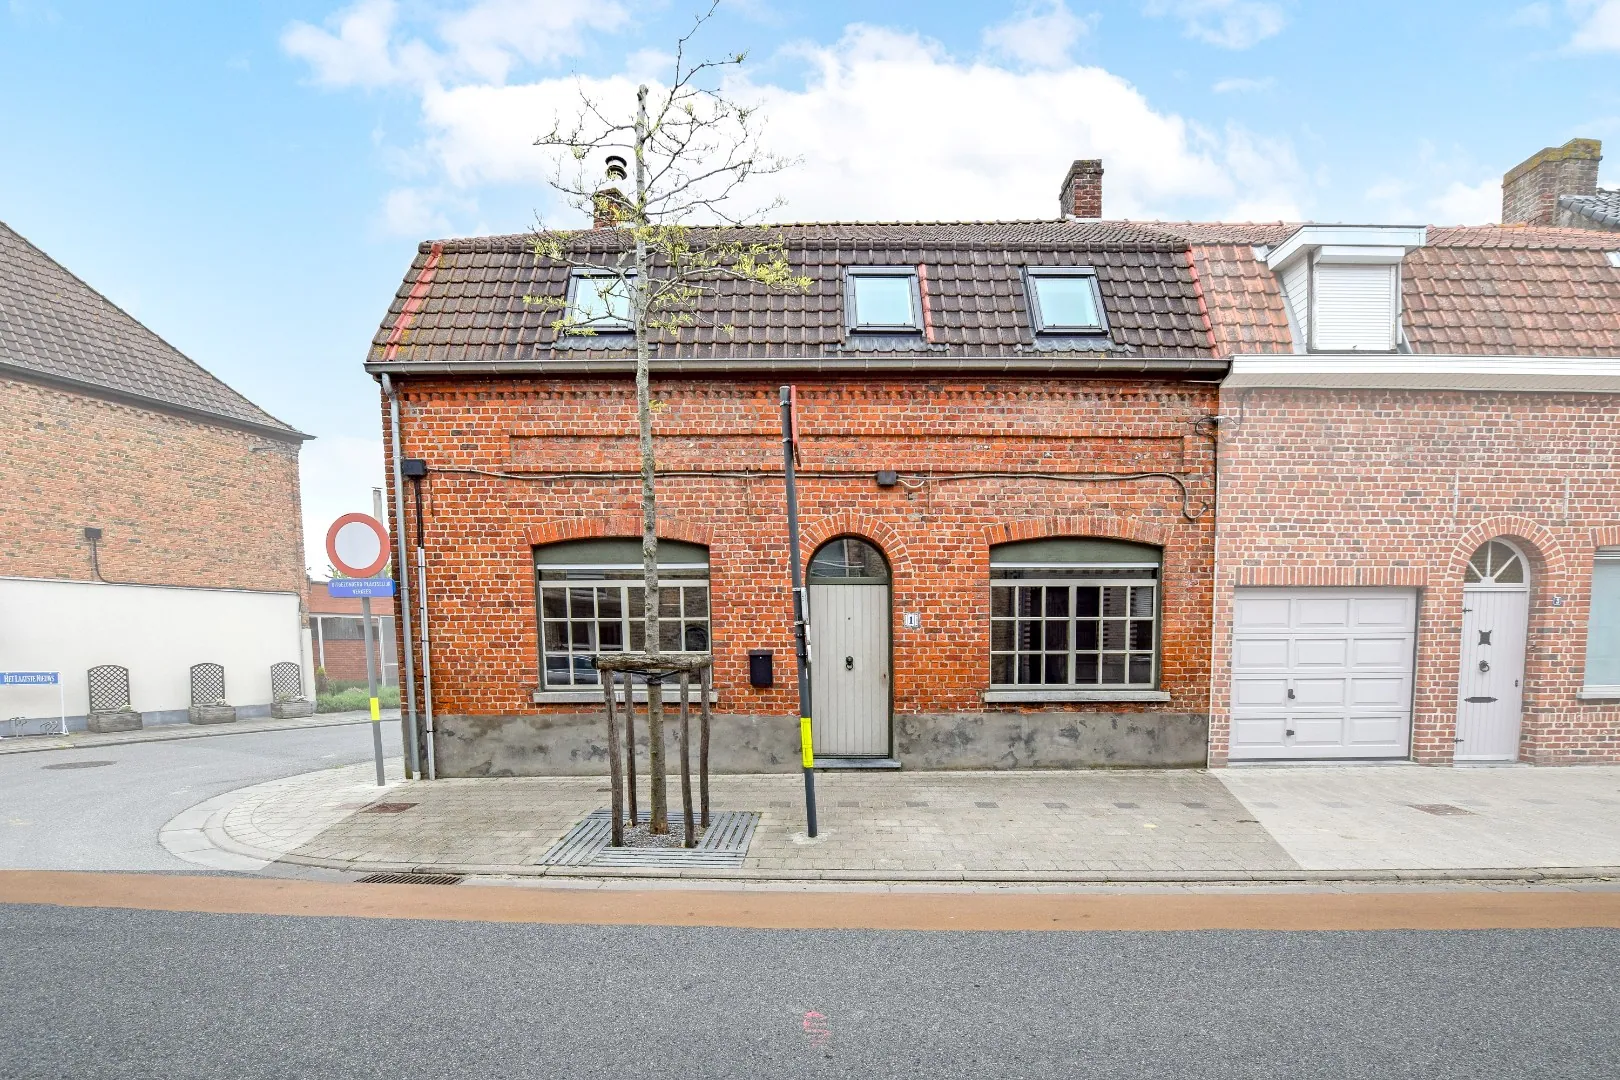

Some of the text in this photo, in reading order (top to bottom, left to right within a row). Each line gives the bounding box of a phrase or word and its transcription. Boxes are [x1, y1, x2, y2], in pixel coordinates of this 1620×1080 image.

[3, 675, 55, 683] HET LAATSTE NIEUWS
